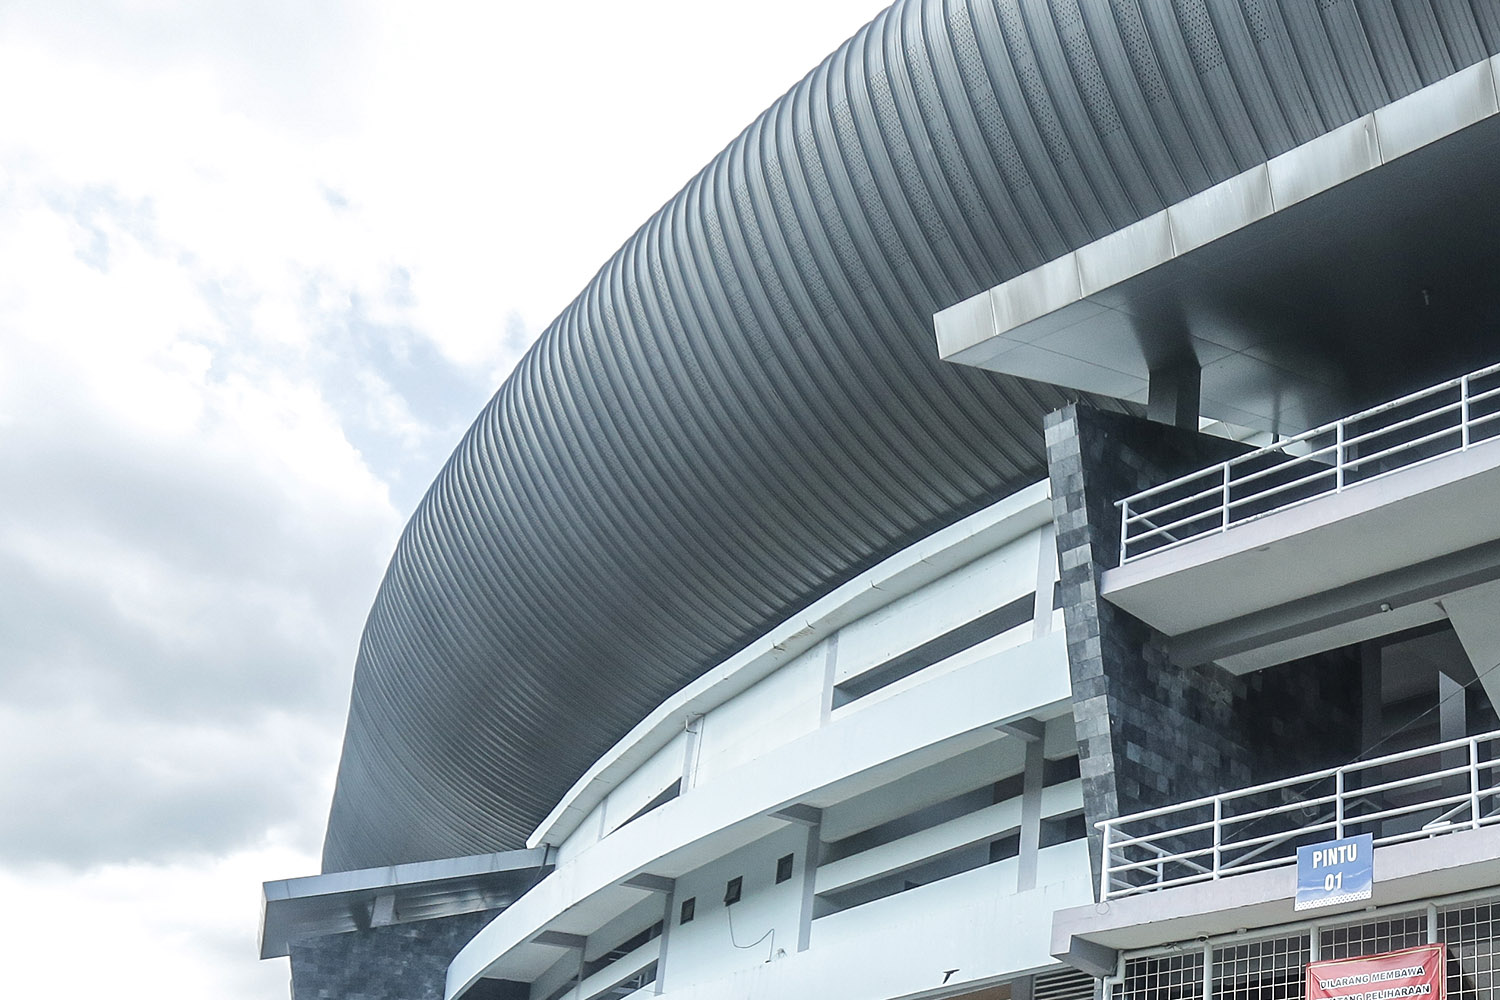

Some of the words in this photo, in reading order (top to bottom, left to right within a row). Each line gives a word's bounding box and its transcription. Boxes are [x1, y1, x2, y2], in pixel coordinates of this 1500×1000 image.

[1312, 843, 1357, 869] PINTU
[1324, 872, 1343, 892] 01
[1320, 975, 1369, 990] DILARANG
[1371, 966, 1425, 982] MEMBAWA
[1365, 984, 1431, 1000] PELIHARAAN
